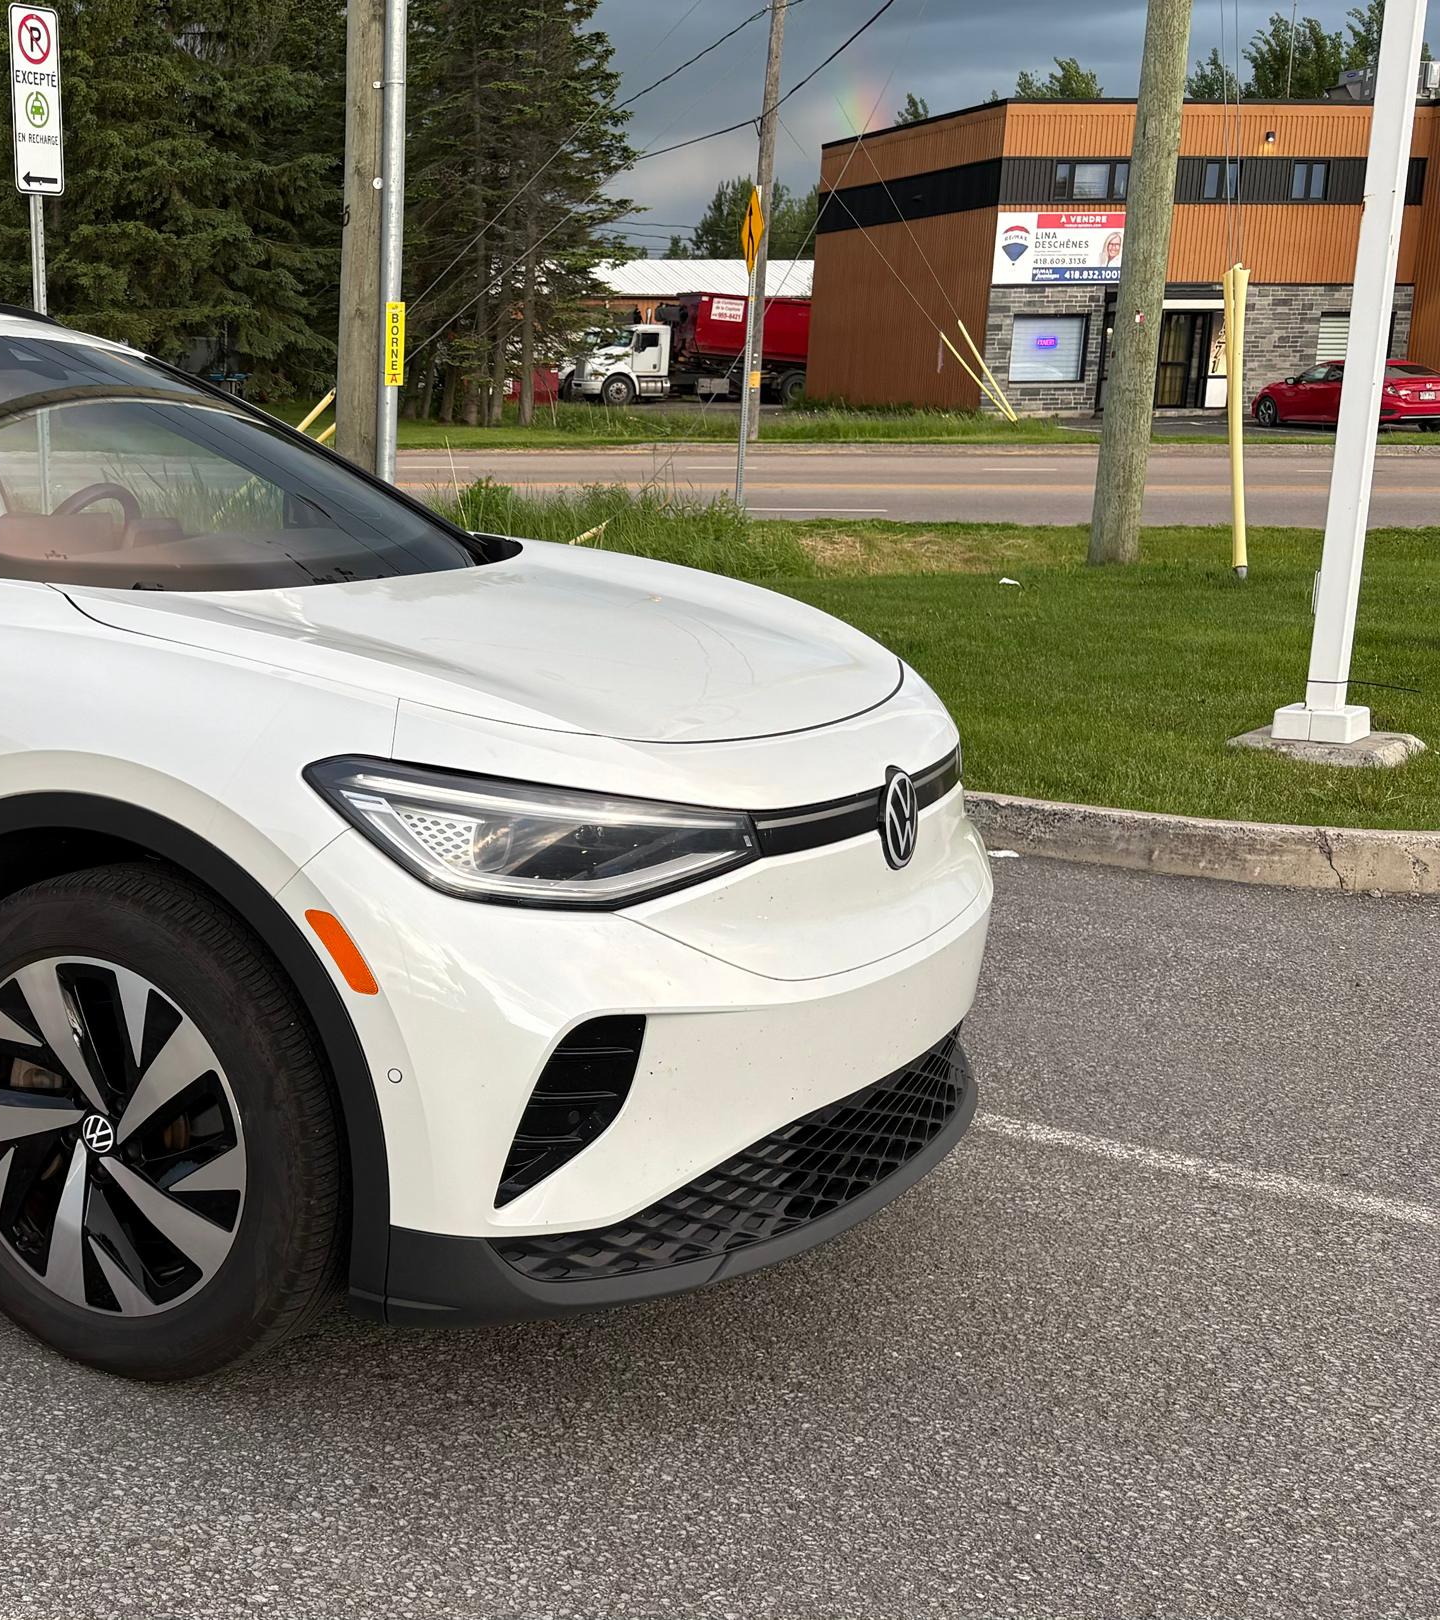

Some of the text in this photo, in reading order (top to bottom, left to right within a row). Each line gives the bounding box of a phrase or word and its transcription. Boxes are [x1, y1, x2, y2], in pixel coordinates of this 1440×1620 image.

[15, 70, 57, 88] EXCEPTÉ
[18, 132, 59, 146] EN RECHARGE
[1060, 214, 1108, 224] À VENDRE
[1035, 231, 1057, 240] LINA
[1034, 239, 1089, 249] DESCHÊNES
[390, 313, 399, 384] BORNE A
